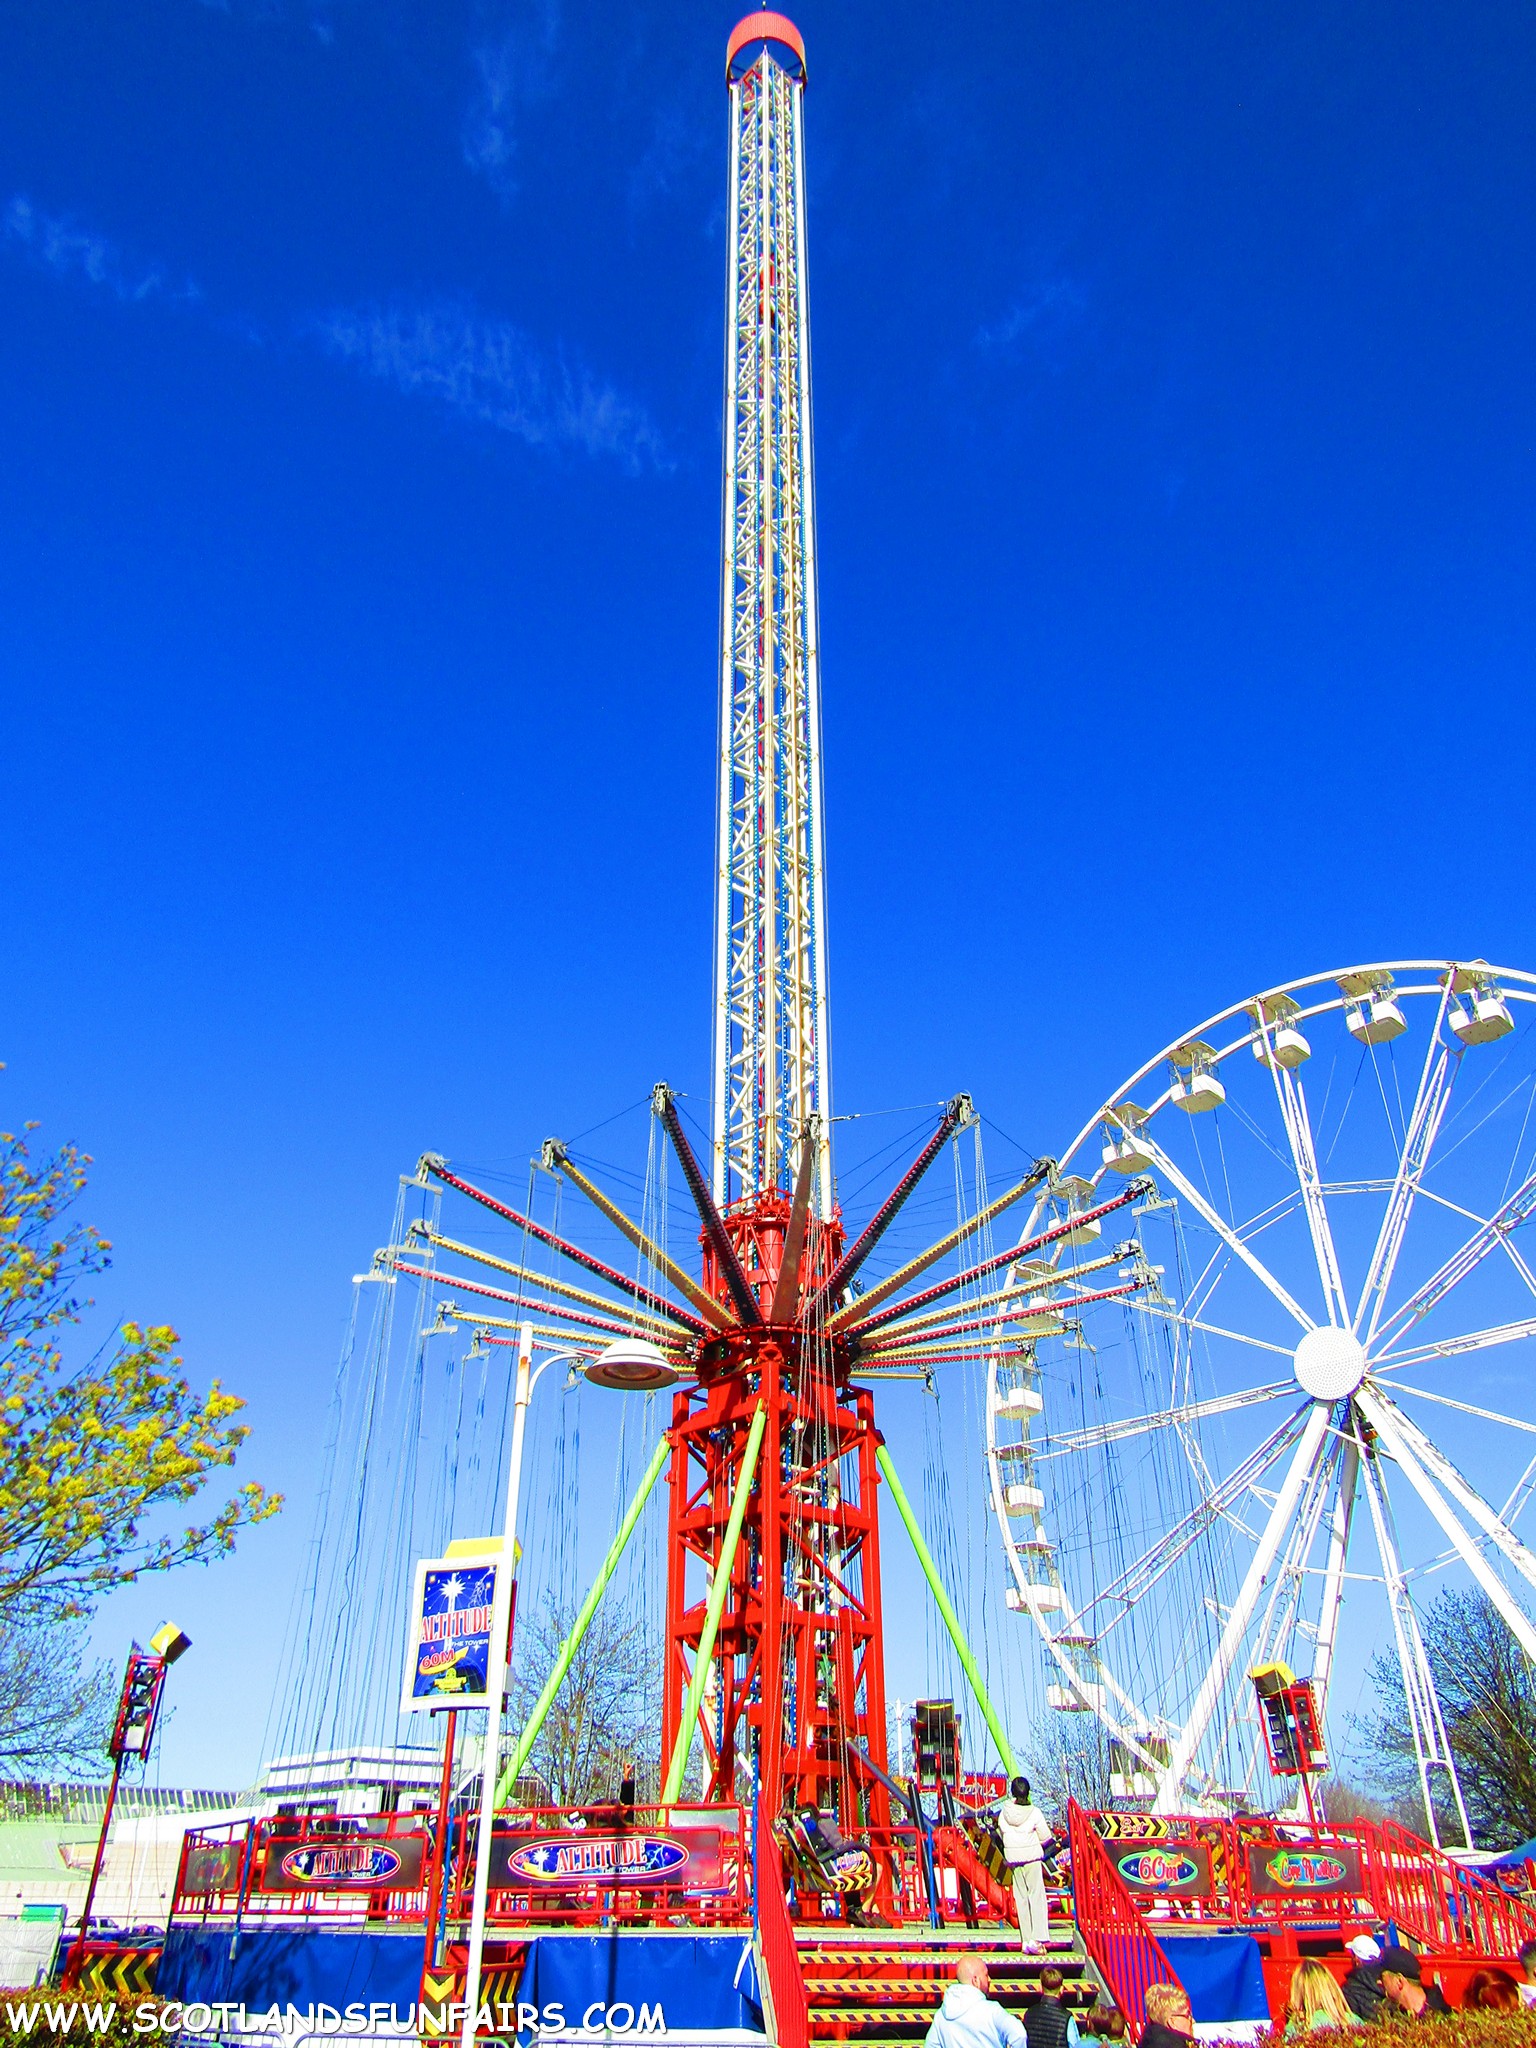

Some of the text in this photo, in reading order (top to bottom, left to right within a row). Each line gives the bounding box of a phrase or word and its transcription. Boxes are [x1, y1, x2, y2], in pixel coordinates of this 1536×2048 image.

[420, 1605, 492, 1644] ALTITUDE
[421, 1650, 455, 1669] 60M
[311, 1846, 374, 1877] ALTITUDE
[556, 1838, 646, 1874] ALTITUDE
[1138, 1856, 1179, 1882] 60m
